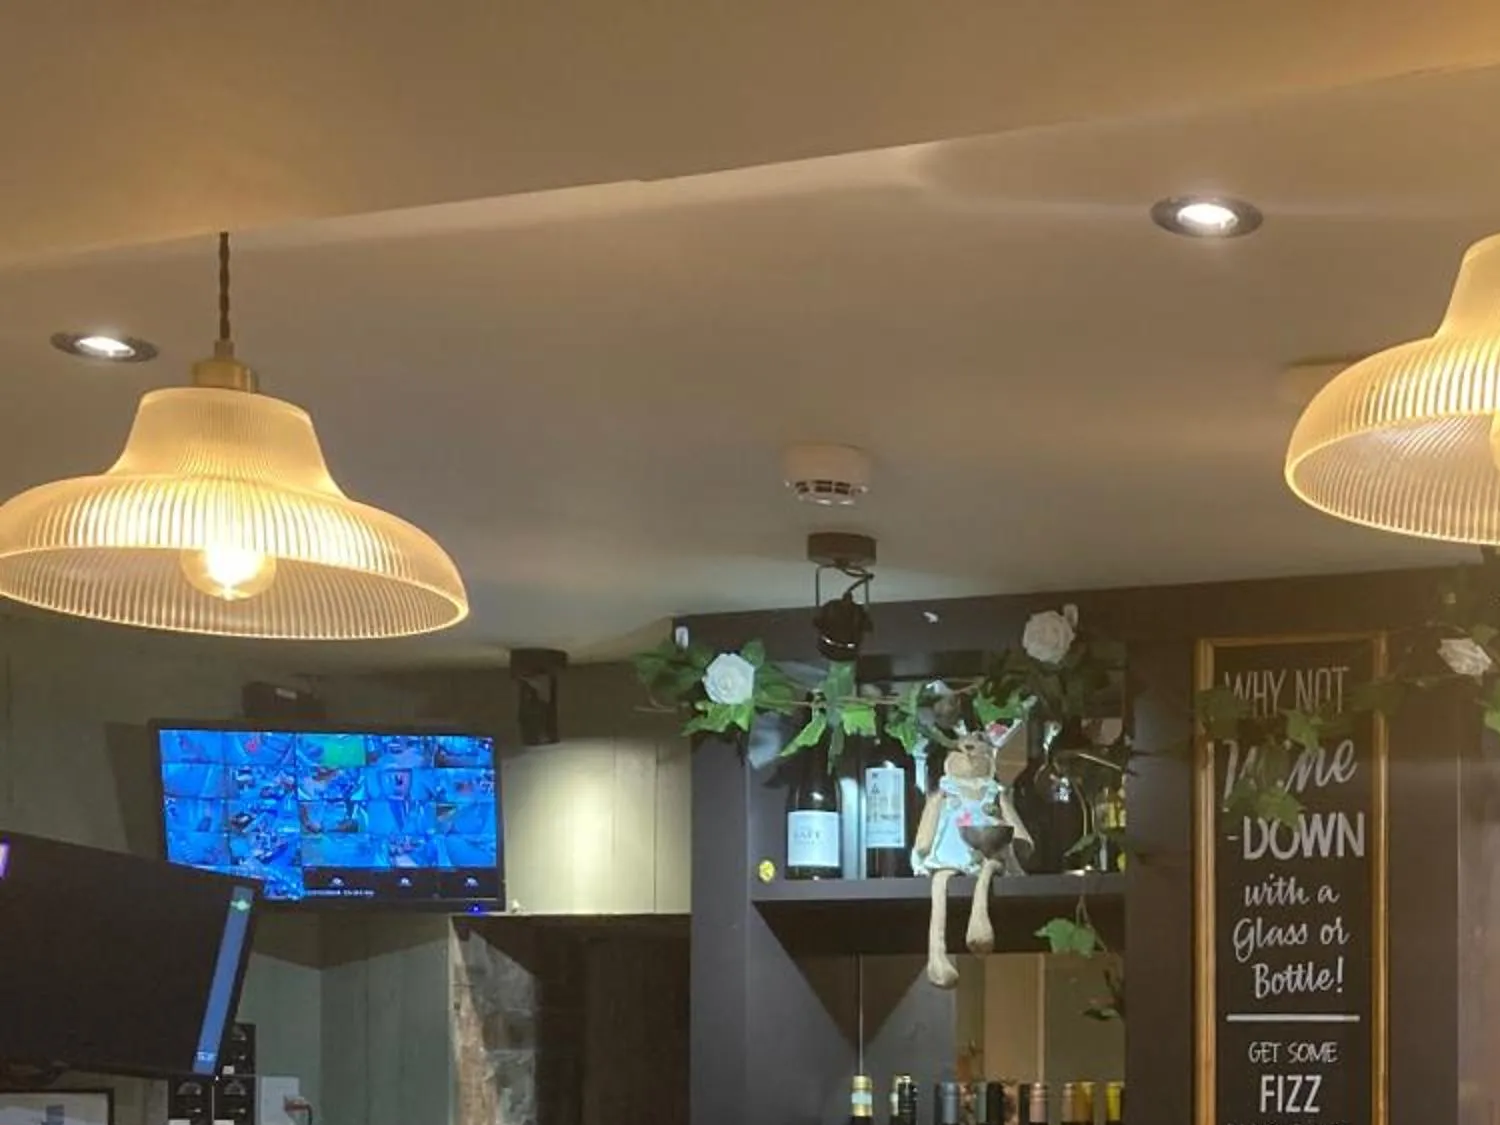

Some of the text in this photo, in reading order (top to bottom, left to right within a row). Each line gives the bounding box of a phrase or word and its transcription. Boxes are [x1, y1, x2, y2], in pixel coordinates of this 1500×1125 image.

[1224, 666, 1350, 718] WHY NOT
[1245, 873, 1340, 906] with a
[1232, 916, 1350, 963] Glass or
[1252, 957, 1345, 998] Bottle!
[1248, 1041, 1339, 1064] GET SOME
[1259, 1074, 1323, 1114] FIZZ
